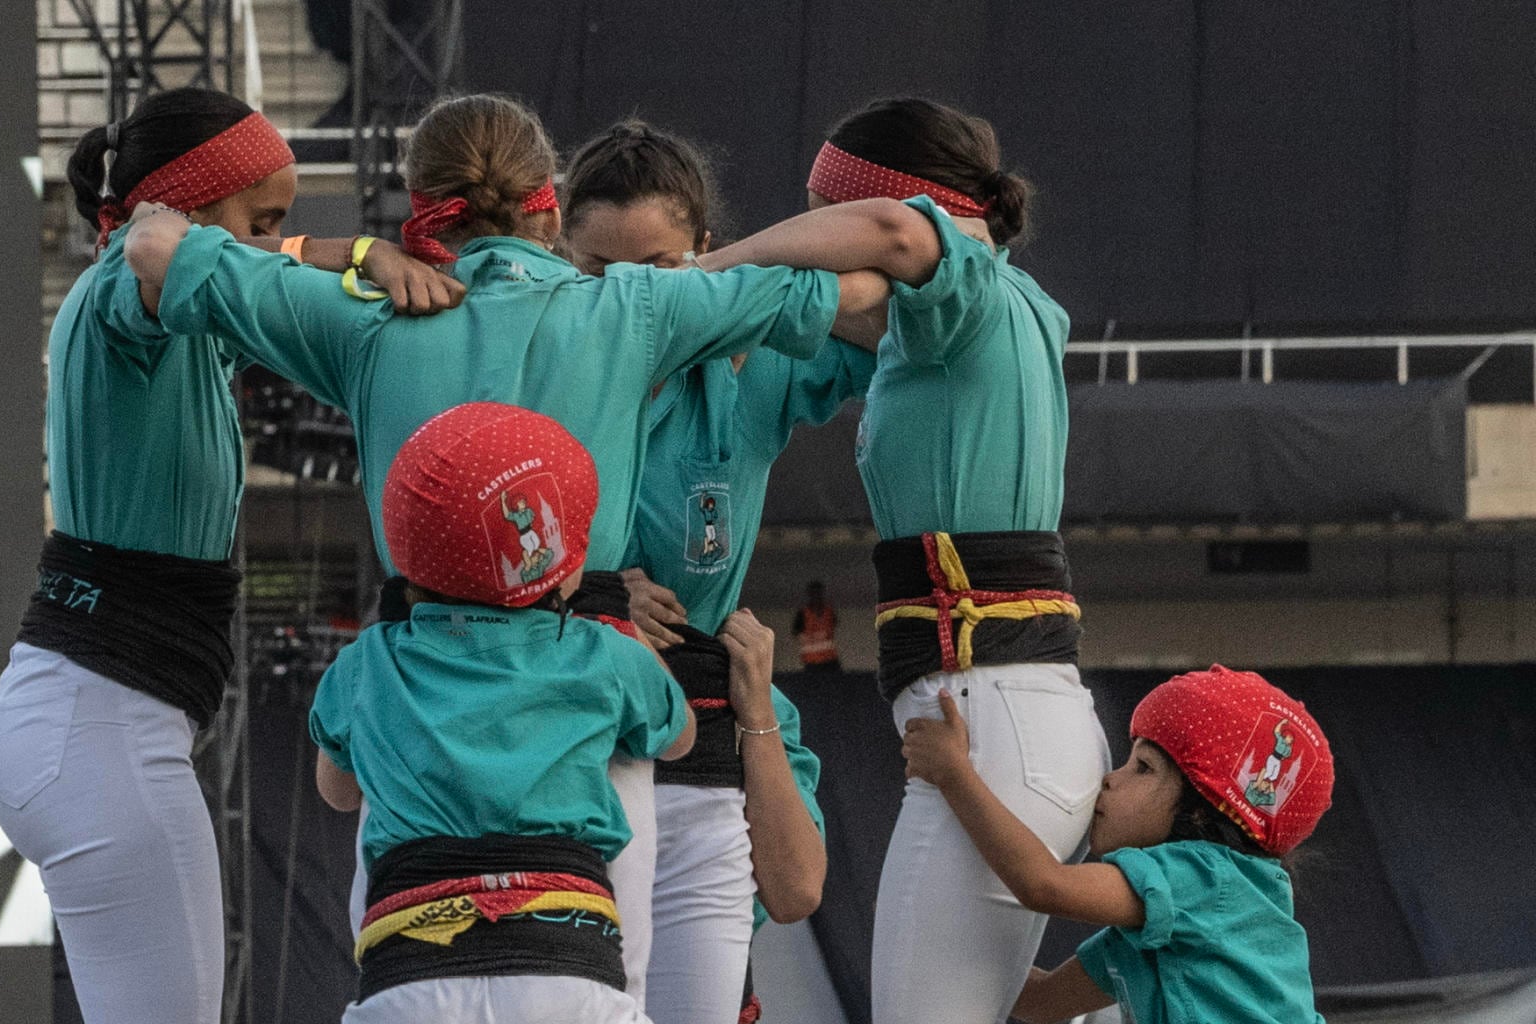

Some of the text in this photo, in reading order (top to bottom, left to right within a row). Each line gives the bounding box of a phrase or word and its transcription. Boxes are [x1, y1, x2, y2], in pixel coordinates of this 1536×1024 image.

[477, 457, 542, 500] CASTELLERS
[1269, 701, 1319, 747] CASTELLERS
[1226, 786, 1266, 827] VILAFRANCA
